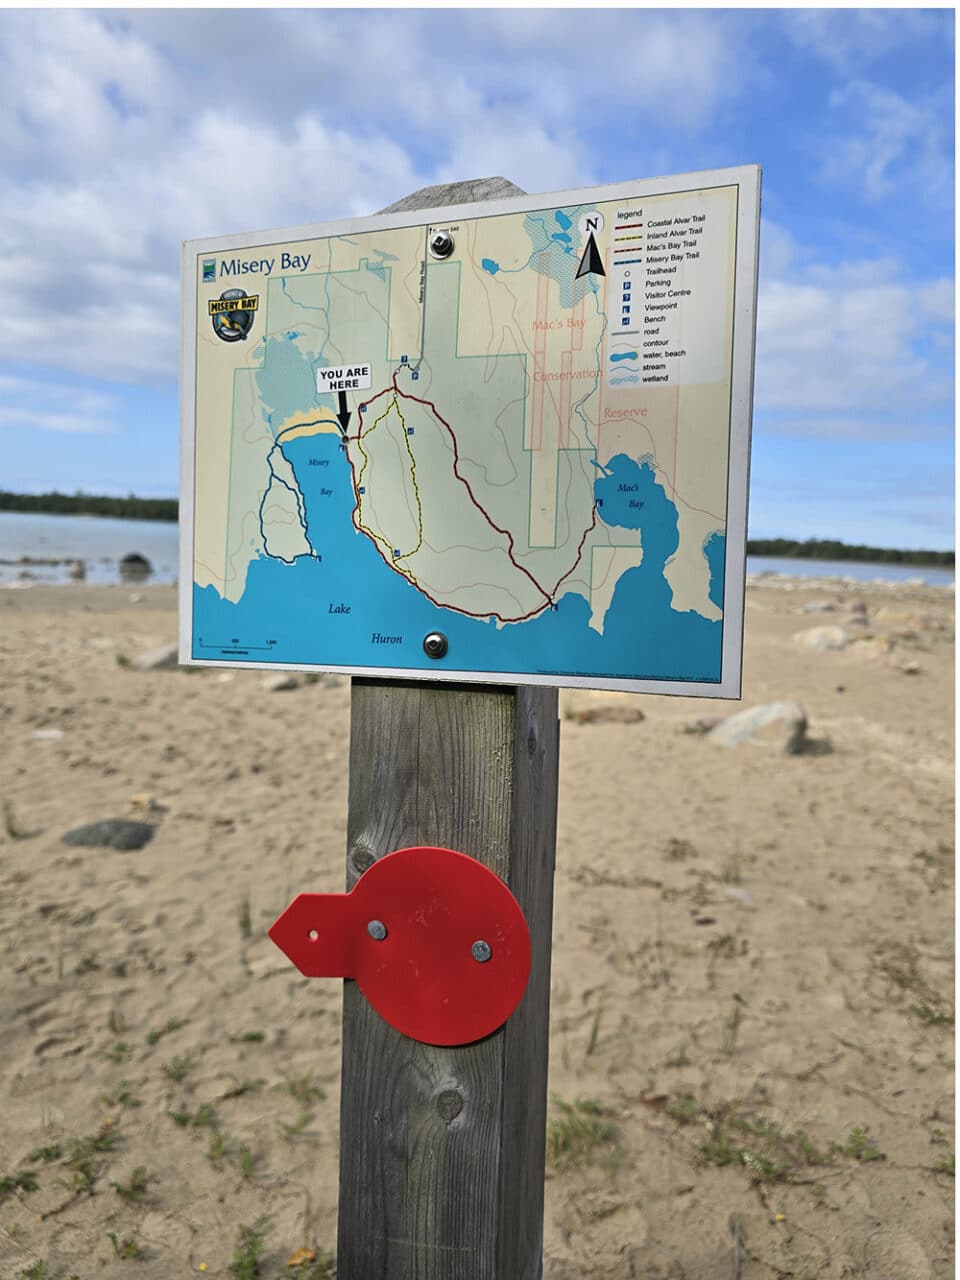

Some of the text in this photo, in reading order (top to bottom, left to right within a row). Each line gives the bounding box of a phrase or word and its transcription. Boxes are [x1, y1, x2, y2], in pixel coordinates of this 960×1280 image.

[618, 210, 642, 219] legend
[585, 218, 598, 230] N
[647, 220, 672, 228] Coastal
[674, 217, 690, 225] Alvar
[647, 240, 697, 251] Mac's Bay Trail
[646, 256, 669, 264] Misery
[671, 254, 684, 262] Bay
[220, 253, 311, 277] Misery Bay
[646, 266, 677, 275] Trailhead
[646, 280, 671, 288] Parking
[211, 299, 256, 312] MISERY BAY
[645, 303, 677, 311] Viewpoint
[532, 319, 585, 330] Mac's Bay
[320, 367, 368, 380] YOU ARE
[533, 370, 603, 382] Conservation
[330, 380, 359, 390] HERE
[604, 407, 648, 418] Reserve
[309, 458, 329, 467] Misery
[320, 488, 332, 496] Bay
[618, 483, 638, 492] Mac's
[629, 499, 644, 509] Bay
[329, 603, 350, 614] Lake
[372, 633, 402, 644] Huron
